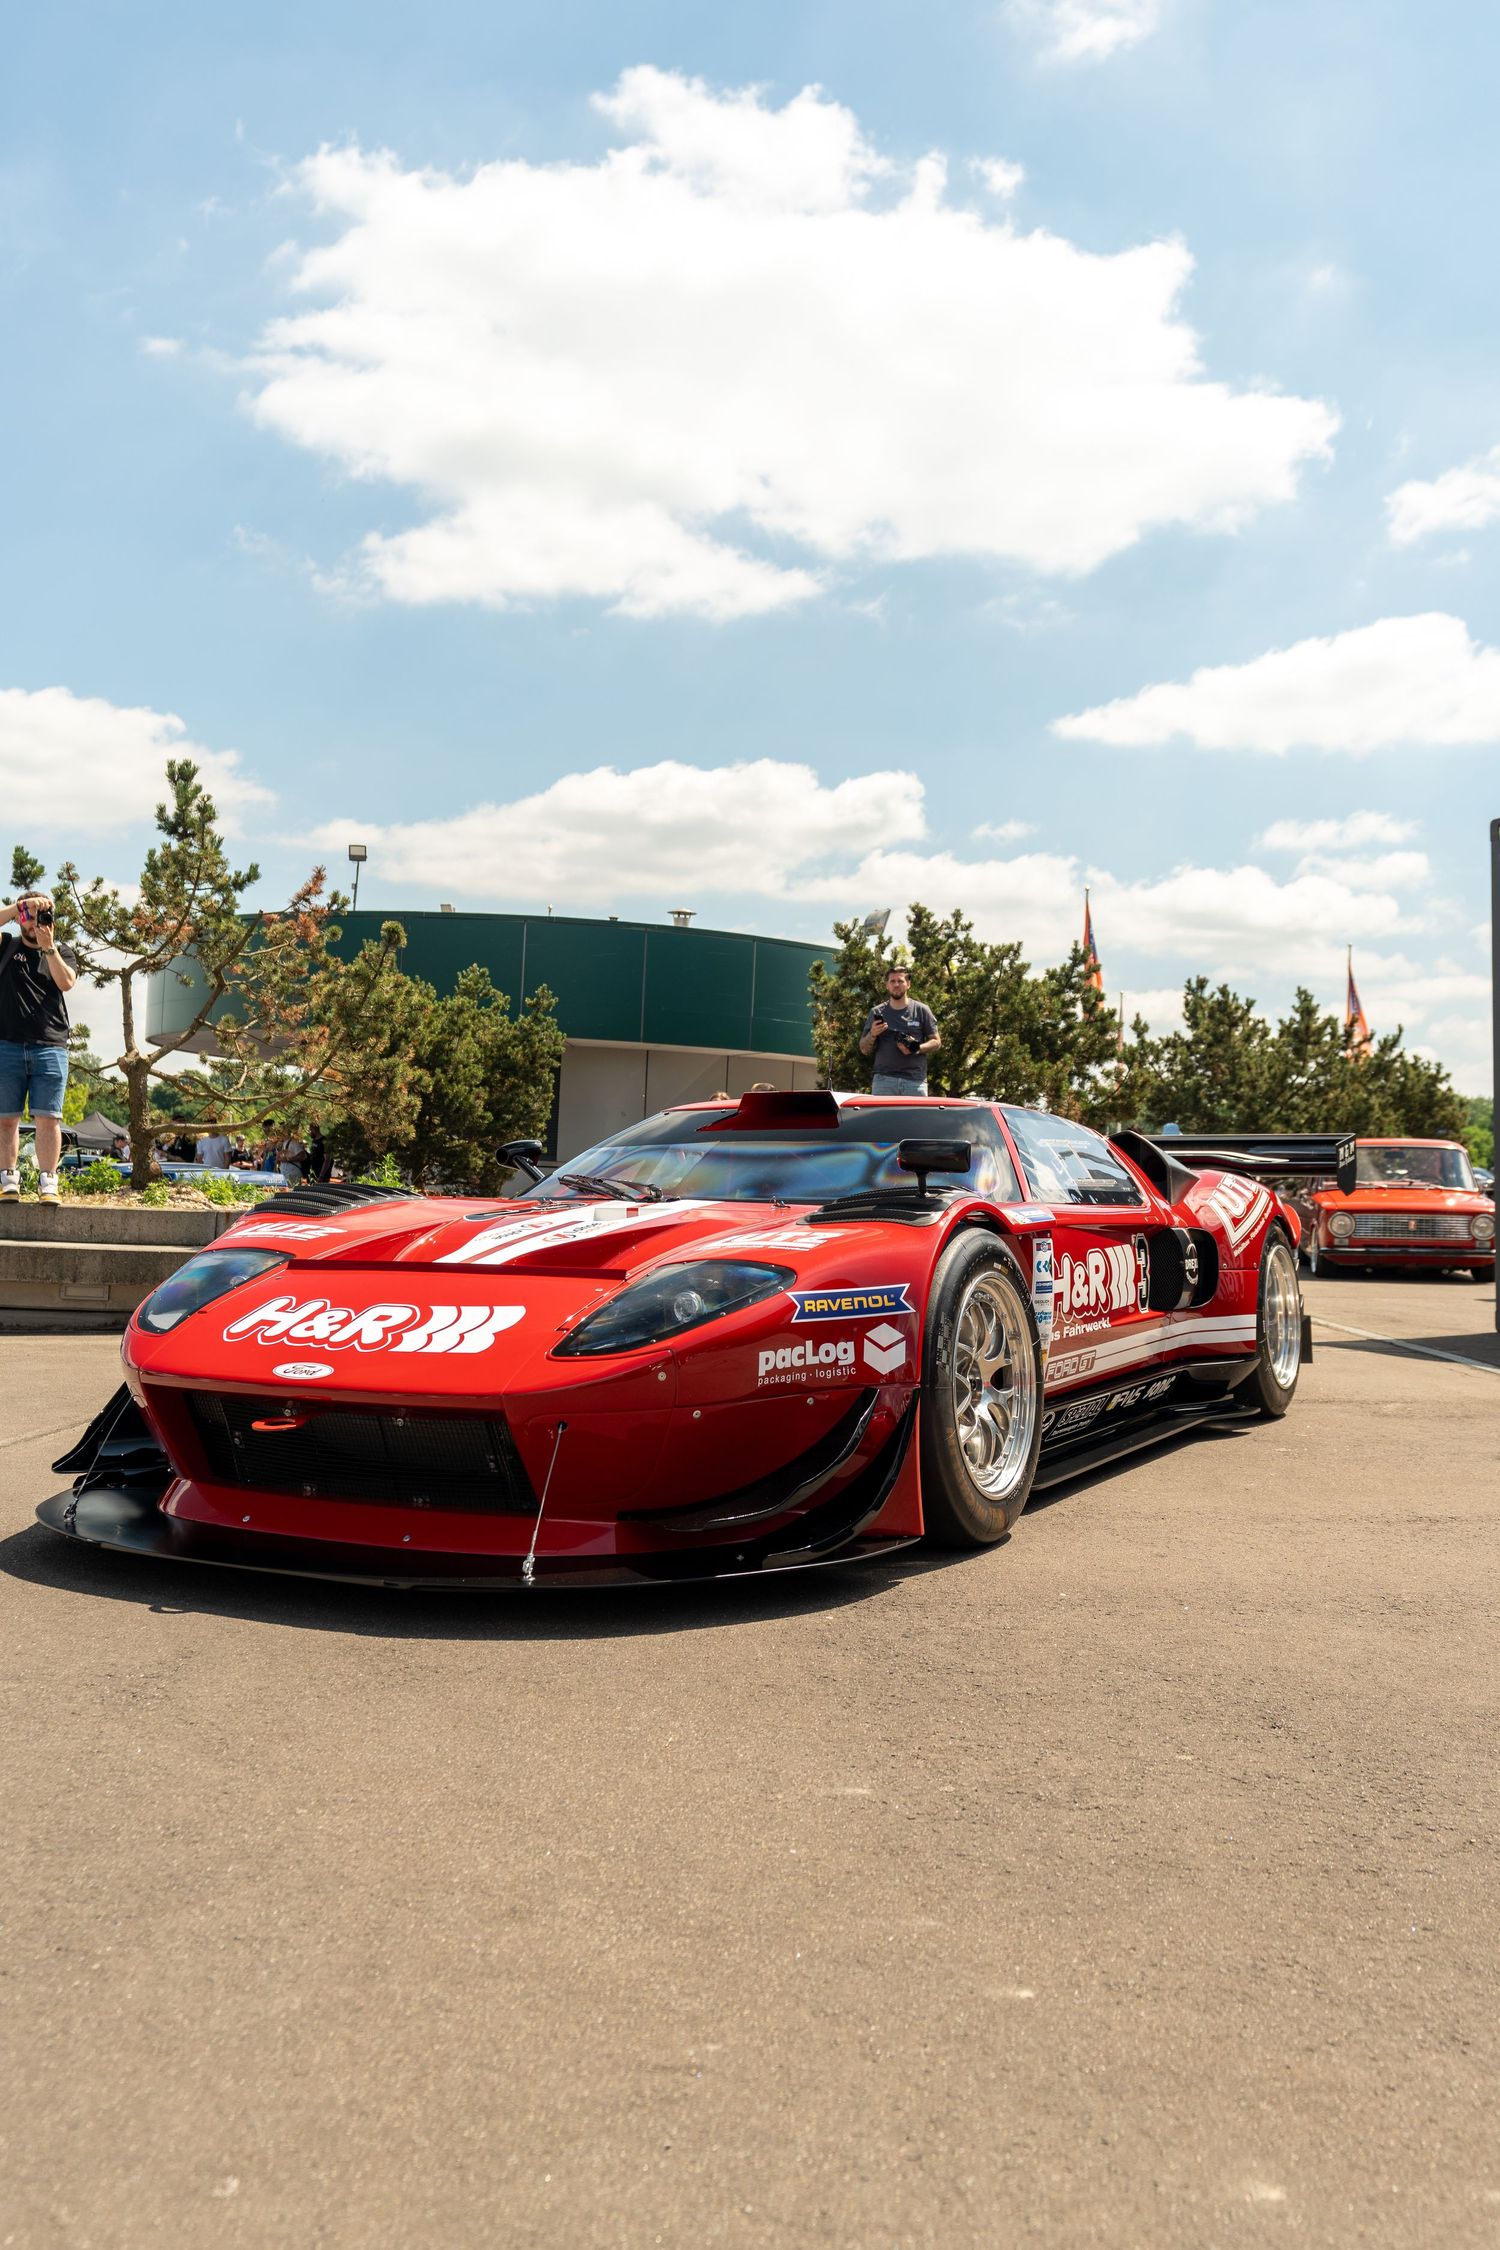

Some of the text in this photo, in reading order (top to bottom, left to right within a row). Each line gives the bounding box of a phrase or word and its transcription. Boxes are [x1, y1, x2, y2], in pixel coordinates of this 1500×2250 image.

[699, 1231, 845, 1250] LUTZ
[1136, 1232, 1150, 1314] 3
[803, 1294, 896, 1313] RAVENOL
[223, 1296, 421, 1353] H&R
[1062, 1316, 1112, 1339] Fahrwerk!
[757, 1339, 856, 1377] pacLog
[1046, 1351, 1097, 1382] FORD GT
[283, 1364, 322, 1376] Ford
[757, 1366, 857, 1388] packaging logistic
